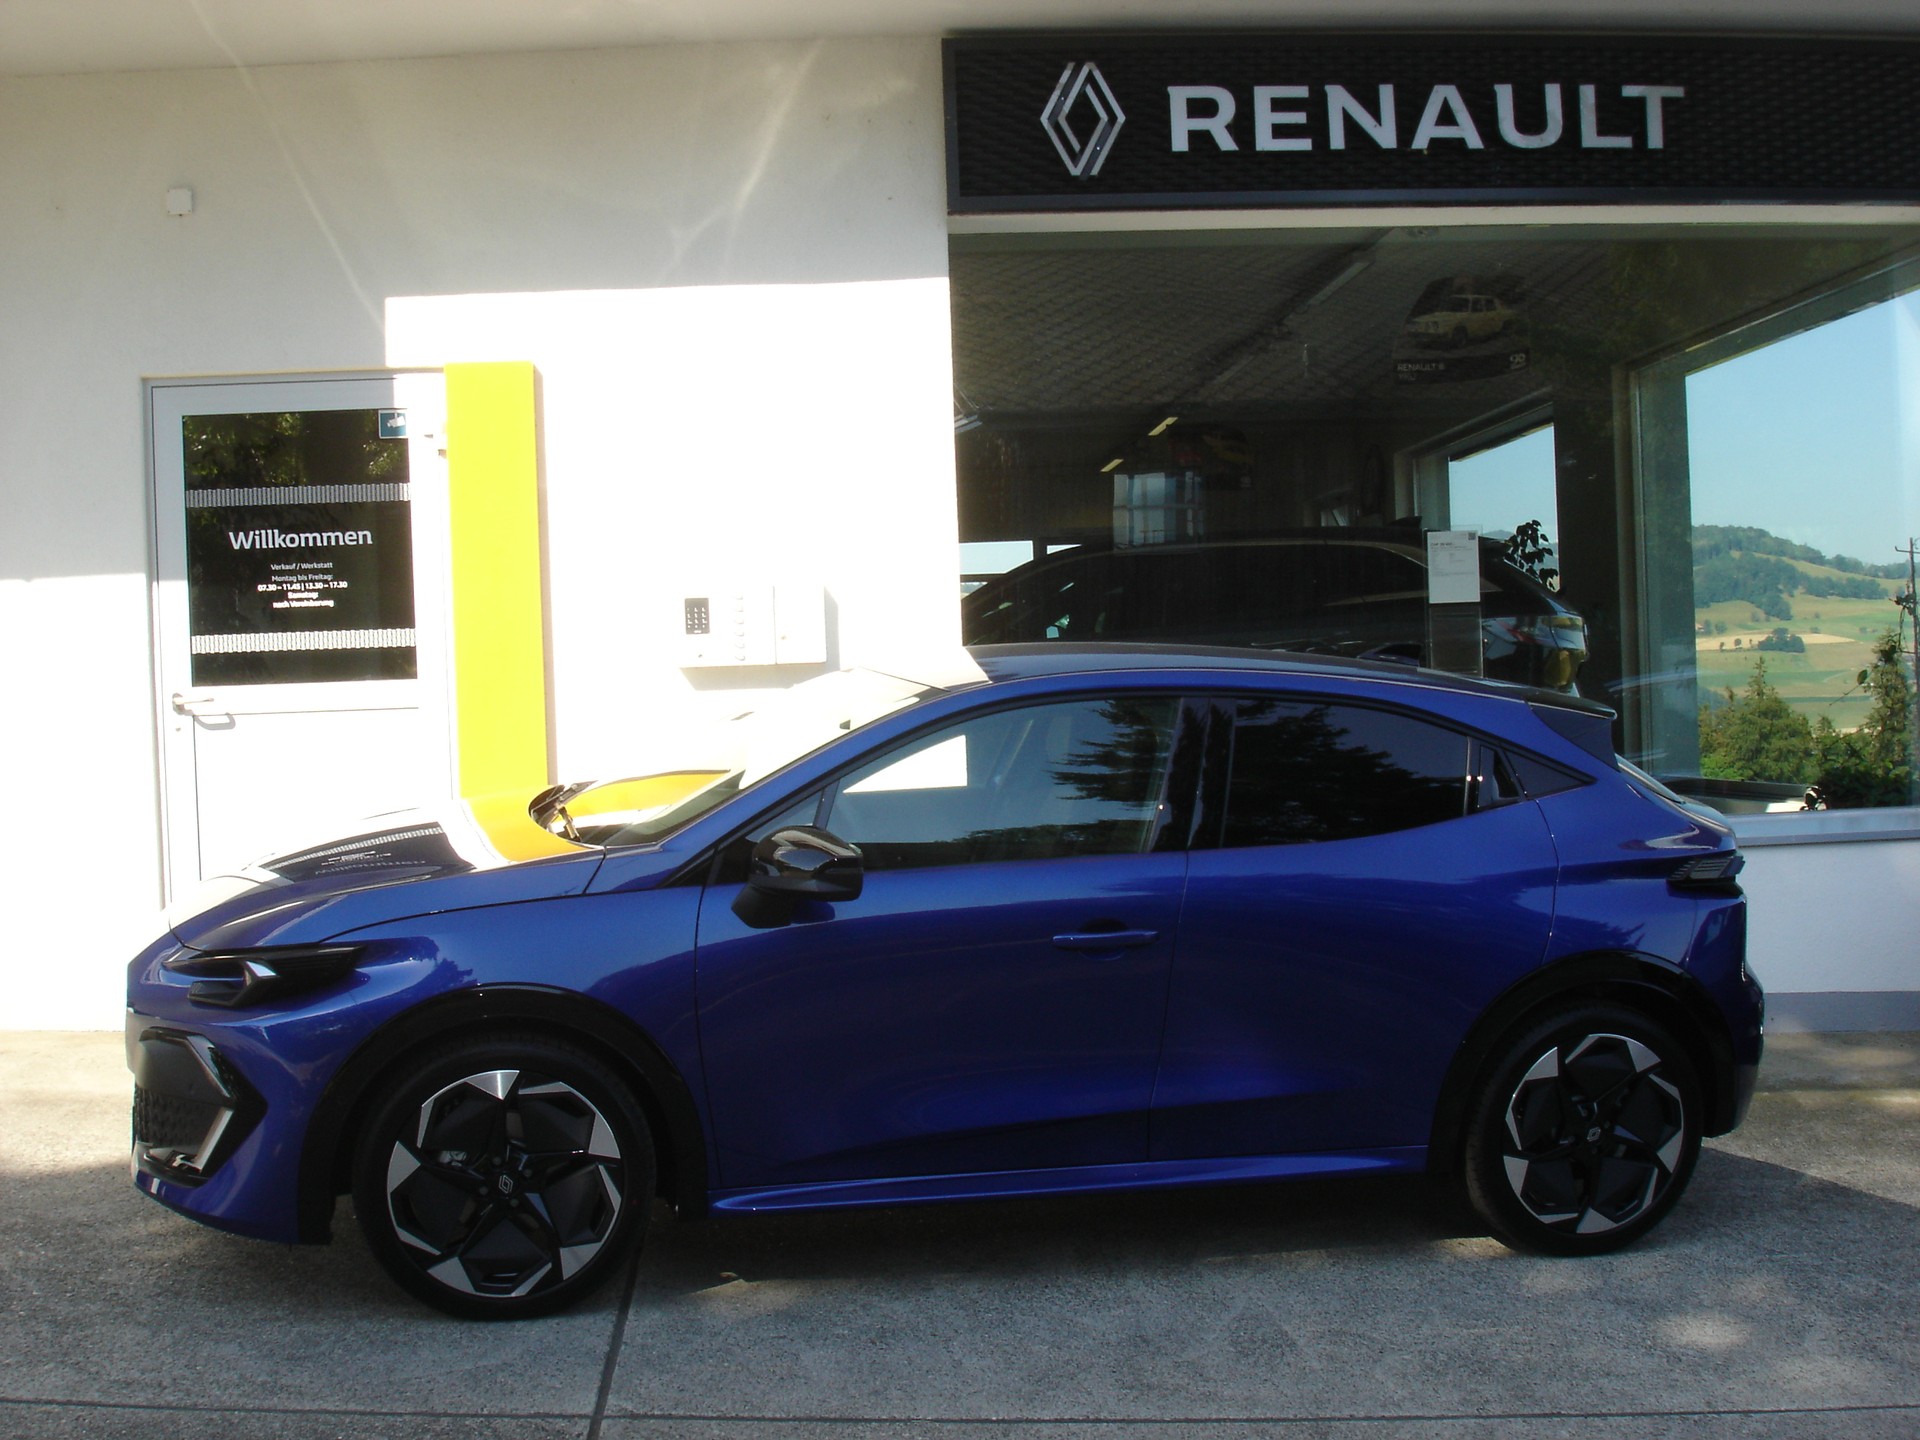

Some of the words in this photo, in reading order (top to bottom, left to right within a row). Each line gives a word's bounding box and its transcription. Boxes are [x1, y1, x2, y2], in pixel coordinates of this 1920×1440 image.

[1167, 83, 1685, 152] RENAULT
[1397, 363, 1435, 372] RENAULT
[228, 529, 373, 550] Willkommen
[270, 563, 296, 571] Verkauf
